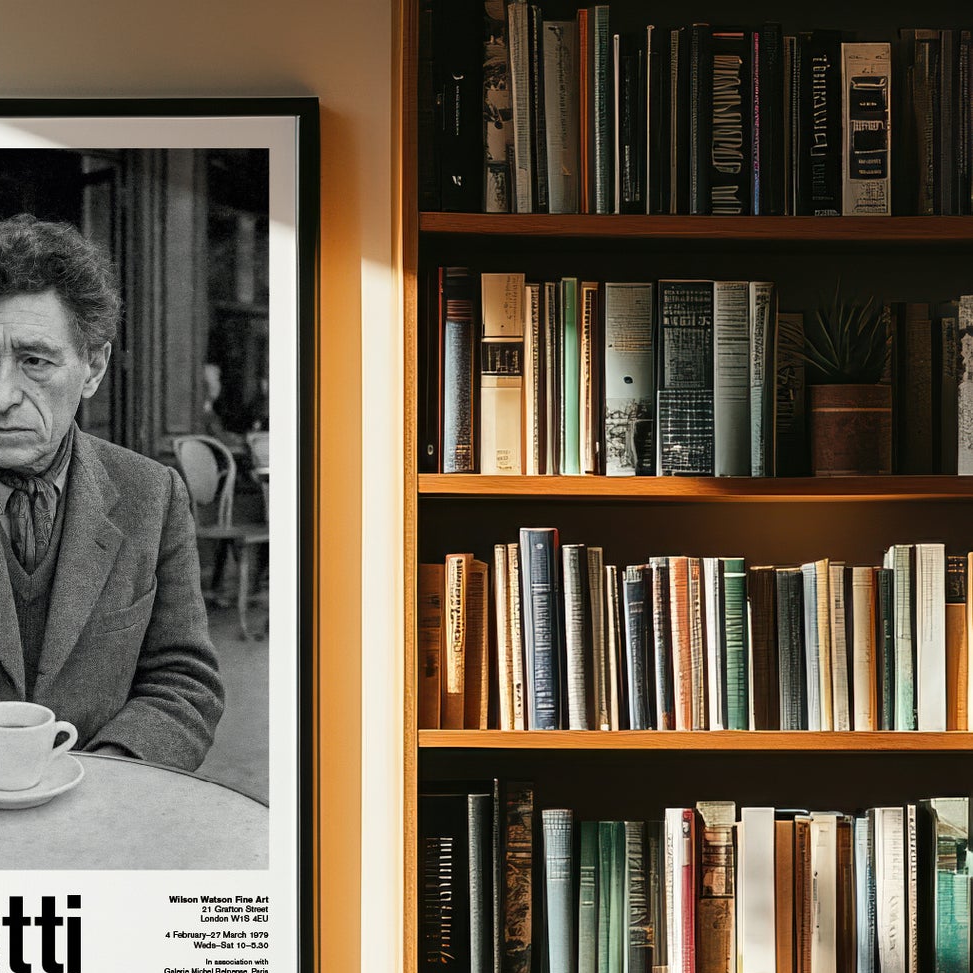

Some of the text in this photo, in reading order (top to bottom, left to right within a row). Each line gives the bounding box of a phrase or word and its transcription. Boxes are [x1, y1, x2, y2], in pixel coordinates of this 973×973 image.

[169, 896, 270, 904] Wilson Watson Fine Art
[214, 905, 244, 913] Grafton
[245, 905, 269, 913] Street
[200, 915, 269, 923] London W1S 4EU
[222, 931, 247, 939] March
